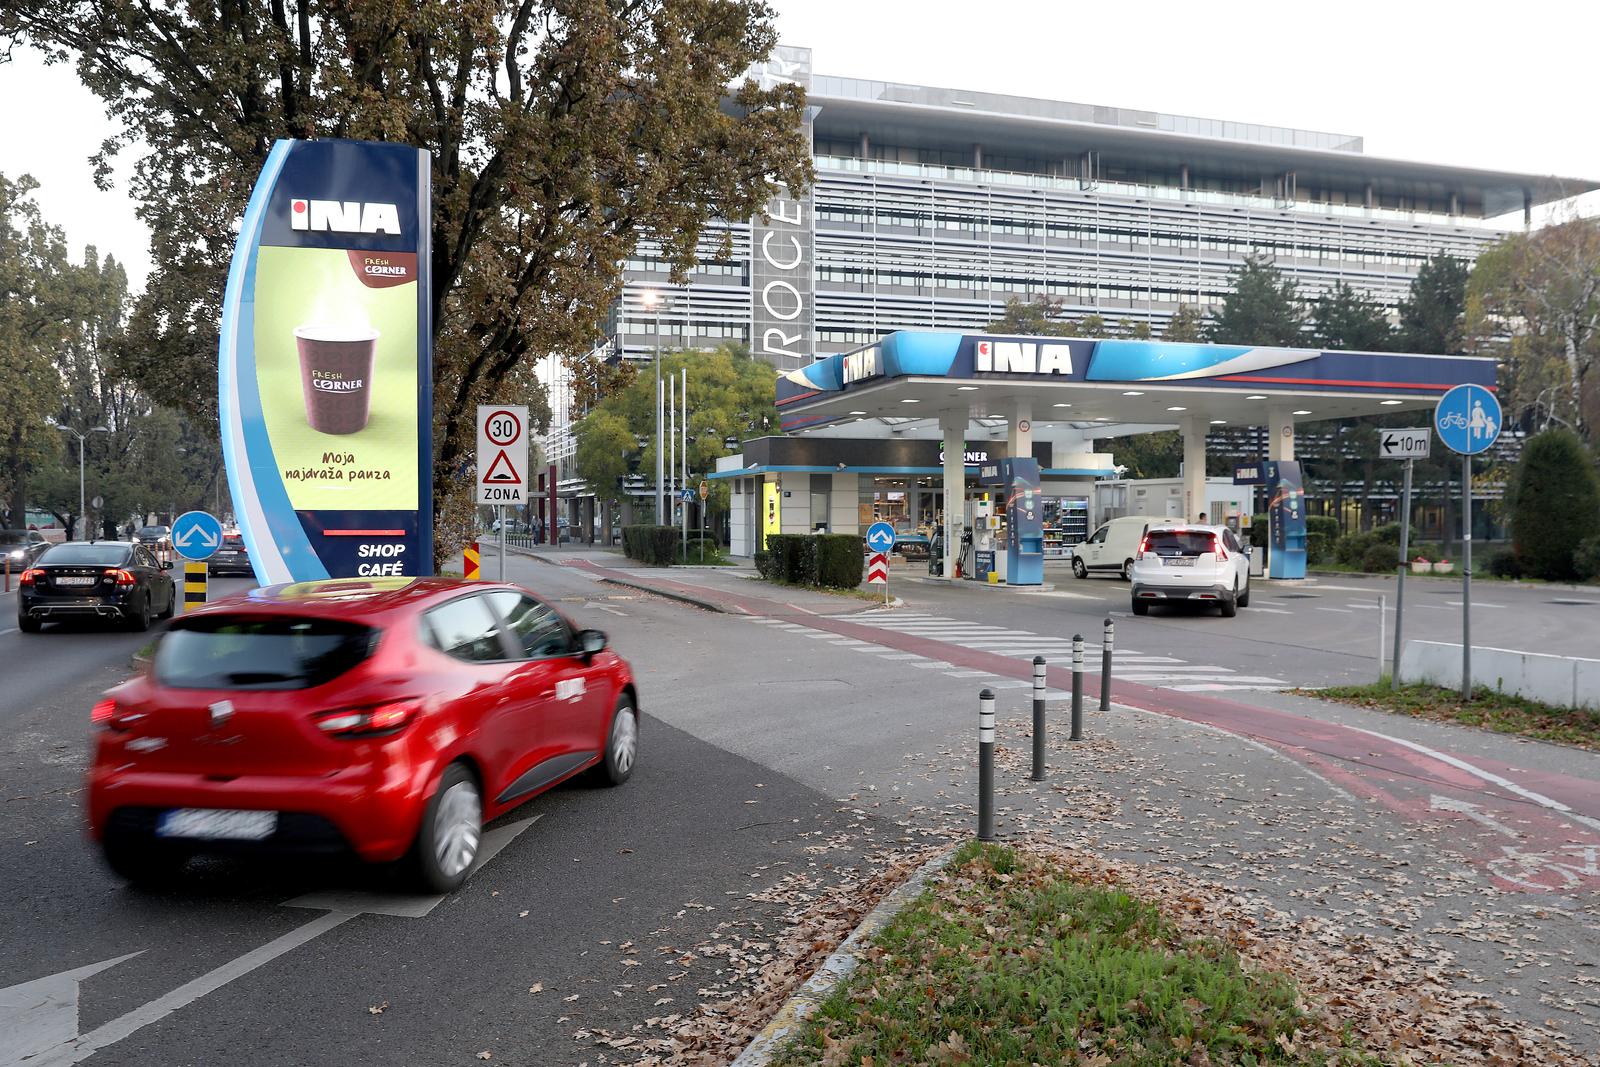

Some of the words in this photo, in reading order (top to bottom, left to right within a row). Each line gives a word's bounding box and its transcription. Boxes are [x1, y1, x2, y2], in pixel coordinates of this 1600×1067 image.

[365, 266, 407, 275] CORNER
[312, 370, 342, 379] FRESH
[313, 379, 363, 389] CORNER
[493, 420, 513, 437] 30
[322, 452, 355, 465] Moja
[285, 466, 343, 481] najdraža
[1268, 467, 1275, 478] 3
[484, 488, 520, 500] ZONA
[358, 544, 406, 557] SHOP
[358, 561, 404, 576] CAFÉ
